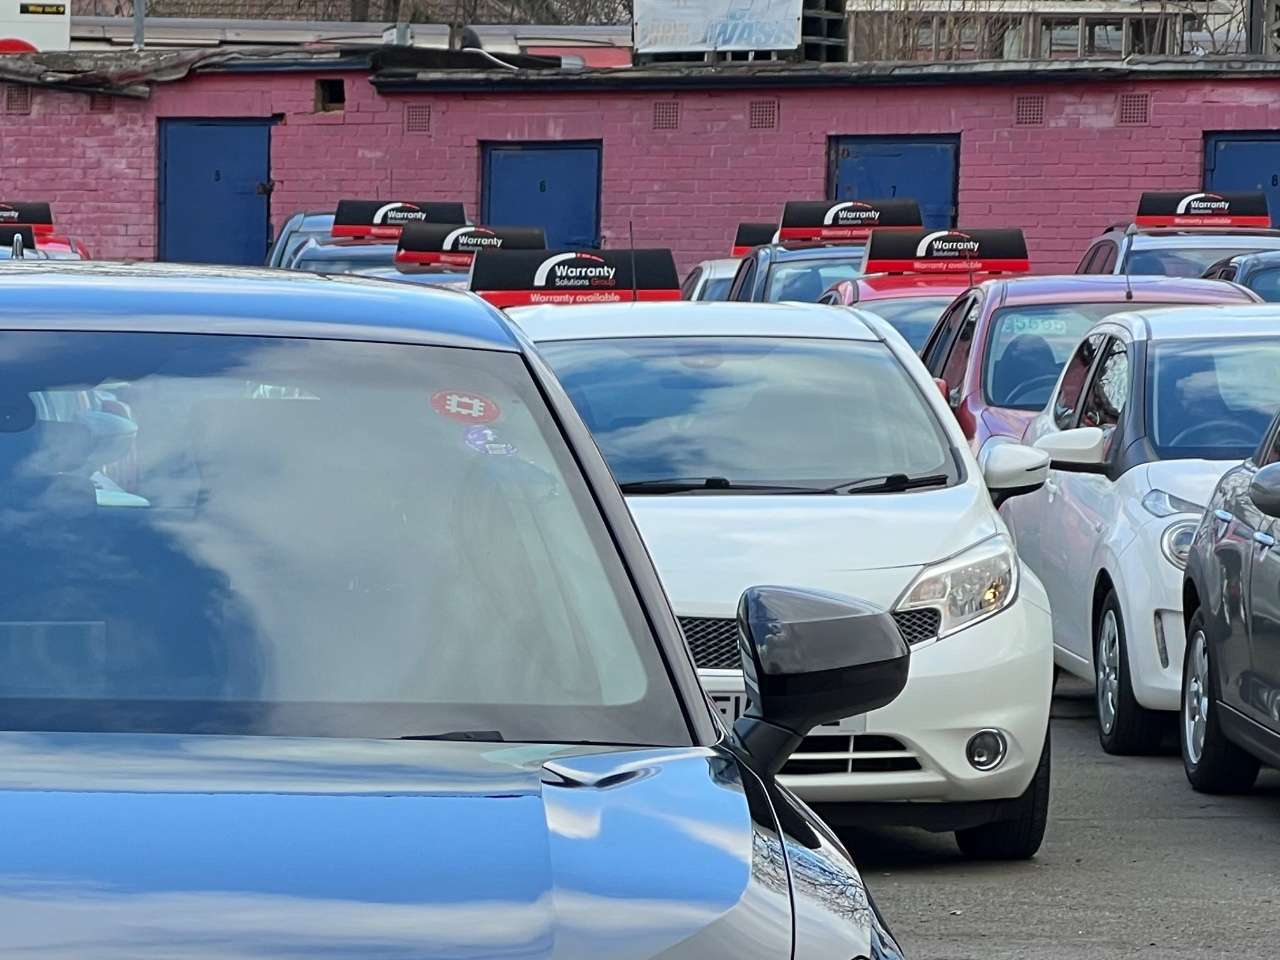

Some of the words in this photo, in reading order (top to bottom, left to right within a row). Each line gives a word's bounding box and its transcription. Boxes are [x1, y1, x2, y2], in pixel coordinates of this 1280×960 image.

[1271, 174, 1279, 187] 8
[1190, 200, 1230, 210] Warranty
[387, 210, 427, 221] Warranty
[839, 210, 881, 220] Warranty
[459, 235, 503, 248] Warranty
[932, 240, 980, 252] Warranty
[555, 265, 617, 280] Warranty
[555, 277, 590, 286] Solutions
[591, 278, 617, 288] Group
[531, 293, 575, 304] Warranty
[576, 292, 621, 302] available
